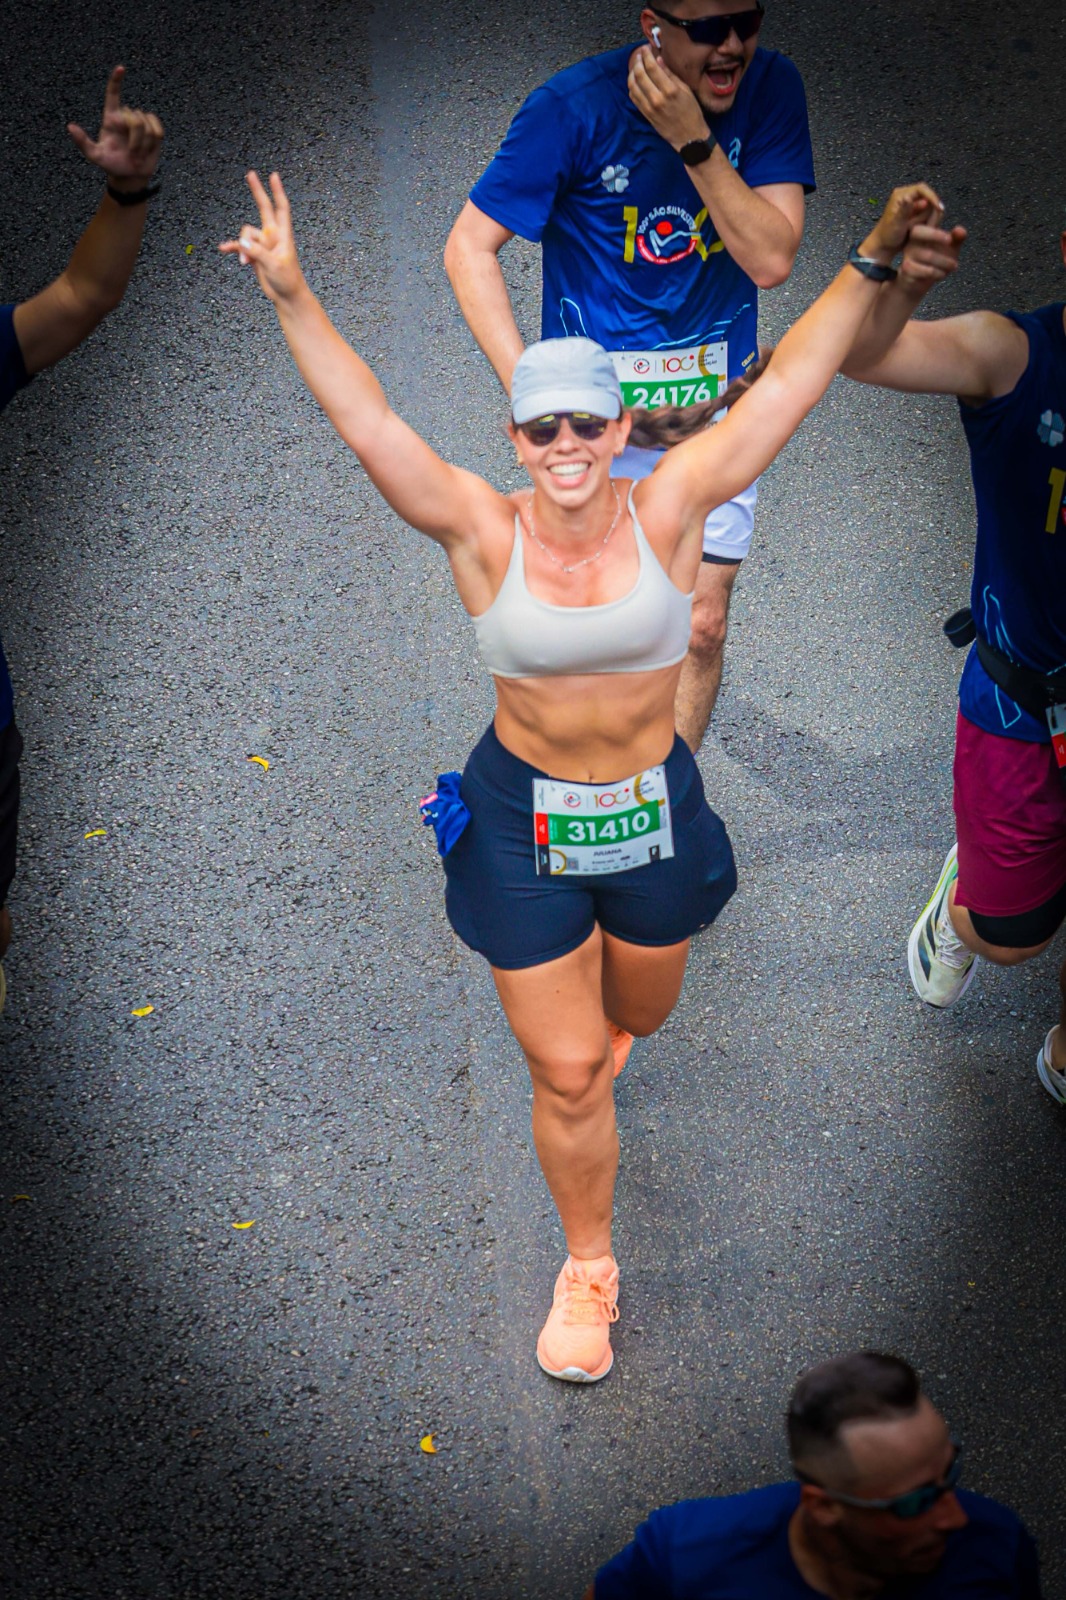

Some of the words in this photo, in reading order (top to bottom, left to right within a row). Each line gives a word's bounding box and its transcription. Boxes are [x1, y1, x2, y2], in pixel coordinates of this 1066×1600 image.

[648, 206, 666, 221] SÃO
[632, 382, 711, 409] 24176
[568, 811, 650, 842] 31410
